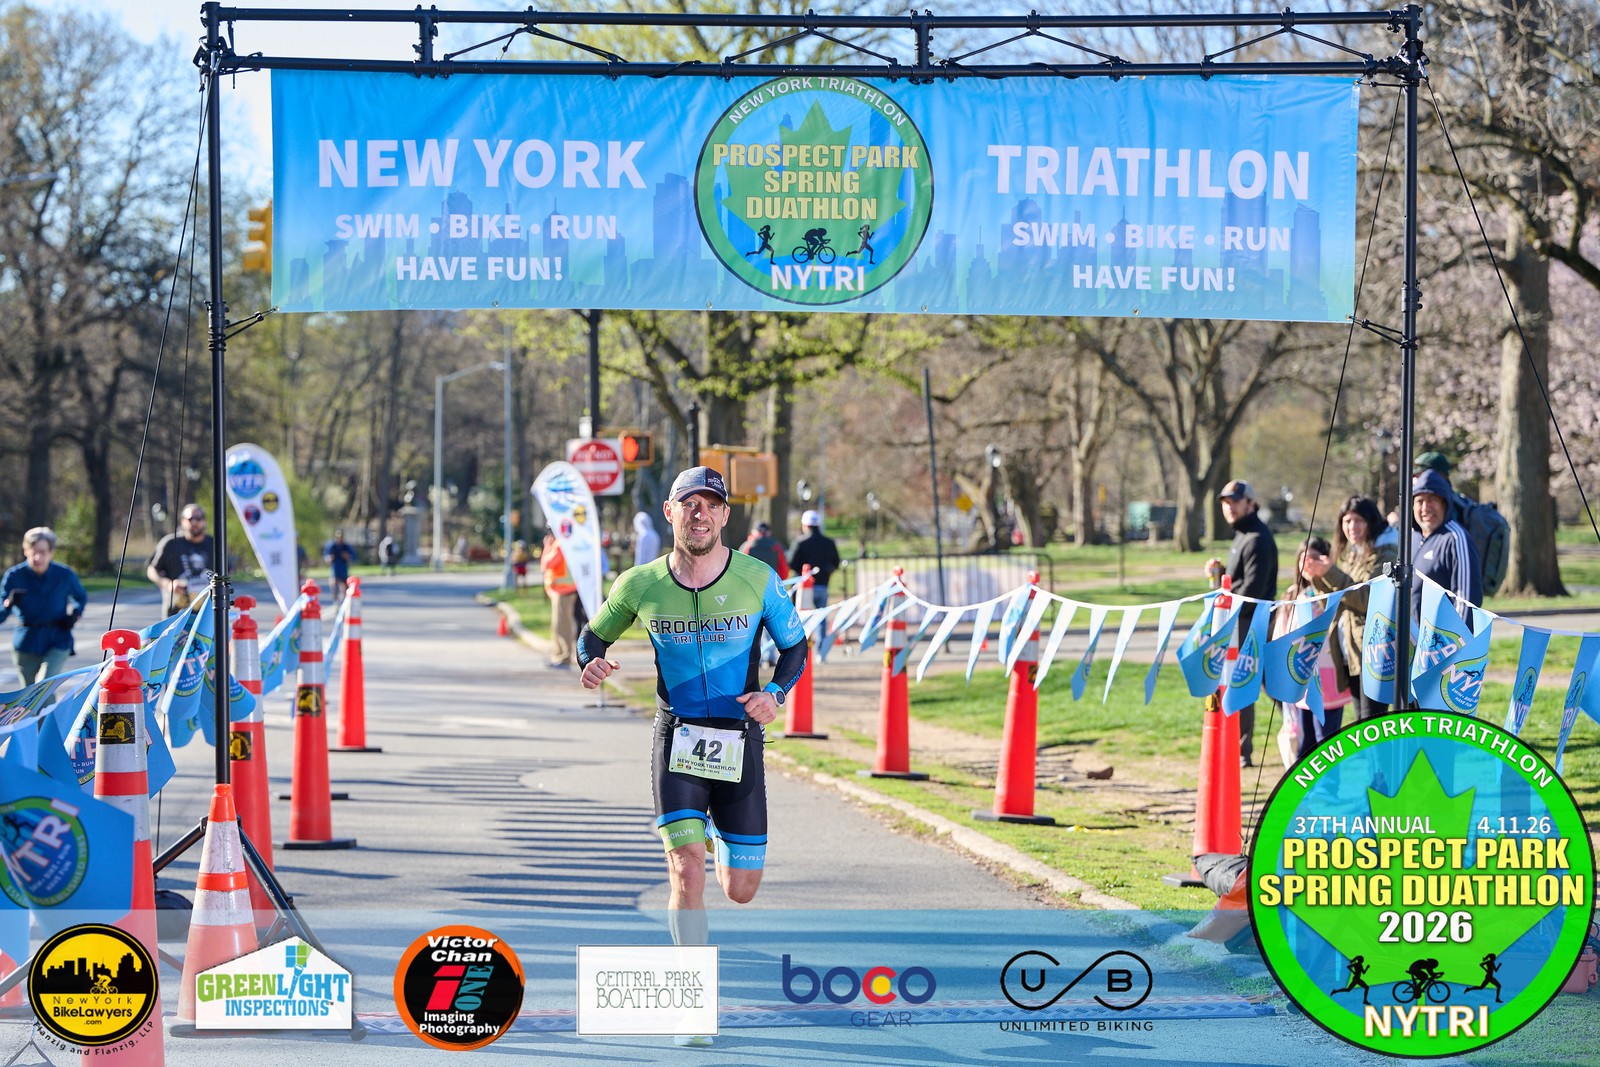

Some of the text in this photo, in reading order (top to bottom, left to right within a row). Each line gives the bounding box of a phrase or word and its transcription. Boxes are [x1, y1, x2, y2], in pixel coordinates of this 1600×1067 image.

[729, 77, 906, 127] NEW YORK TRIATHLON
[318, 139, 646, 188] NEW YORK
[712, 144, 919, 168] PROSPECT PARK
[764, 170, 860, 194] SPRING
[987, 144, 1309, 200] TRIATHLON
[746, 196, 877, 220] DUATHLON
[336, 213, 617, 240] SWIM BIKE RUN
[1012, 221, 1289, 251] SWIM BIKE RUN
[398, 256, 563, 281] HAVE FUN!
[771, 264, 865, 291] NYTRI
[1073, 264, 1236, 291] HAVE FUN!
[650, 614, 748, 634] BROOKLYN
[672, 633, 726, 644] TRI CLUB
[692, 738, 722, 763] 42
